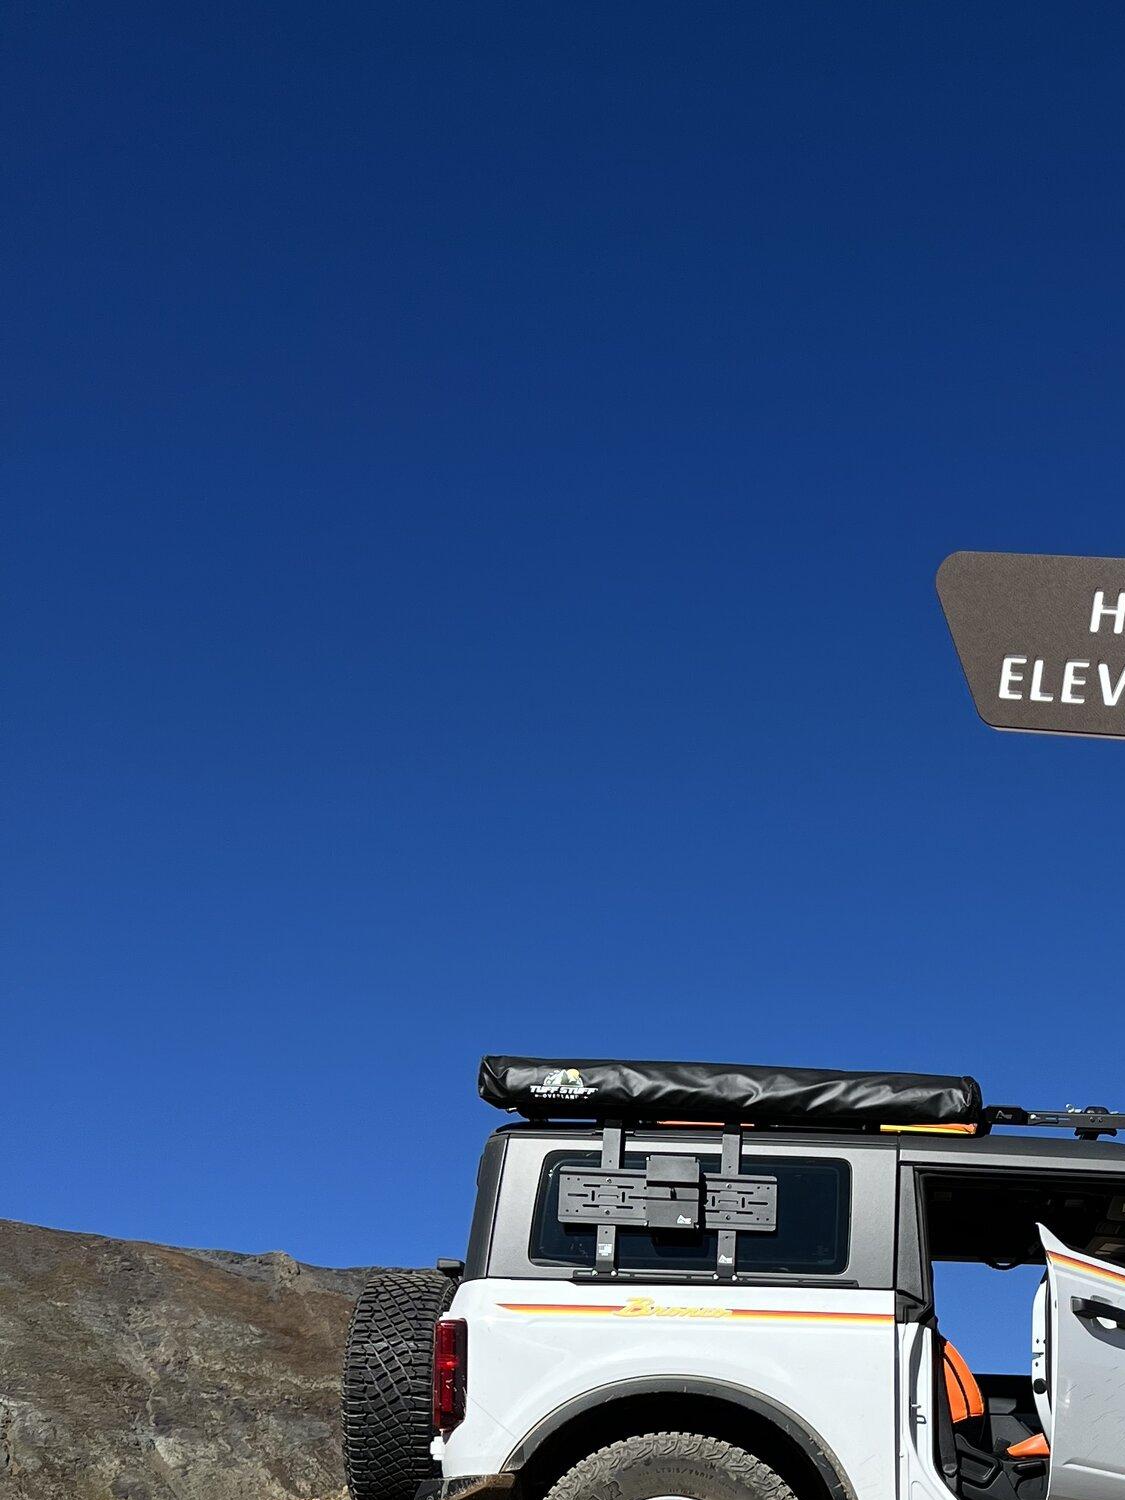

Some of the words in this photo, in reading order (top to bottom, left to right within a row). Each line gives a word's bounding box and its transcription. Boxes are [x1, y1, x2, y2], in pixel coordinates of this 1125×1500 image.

[530, 1085, 560, 1094] TUFF
[559, 1086, 597, 1095] STUFF
[613, 1296, 731, 1318] Bronco
